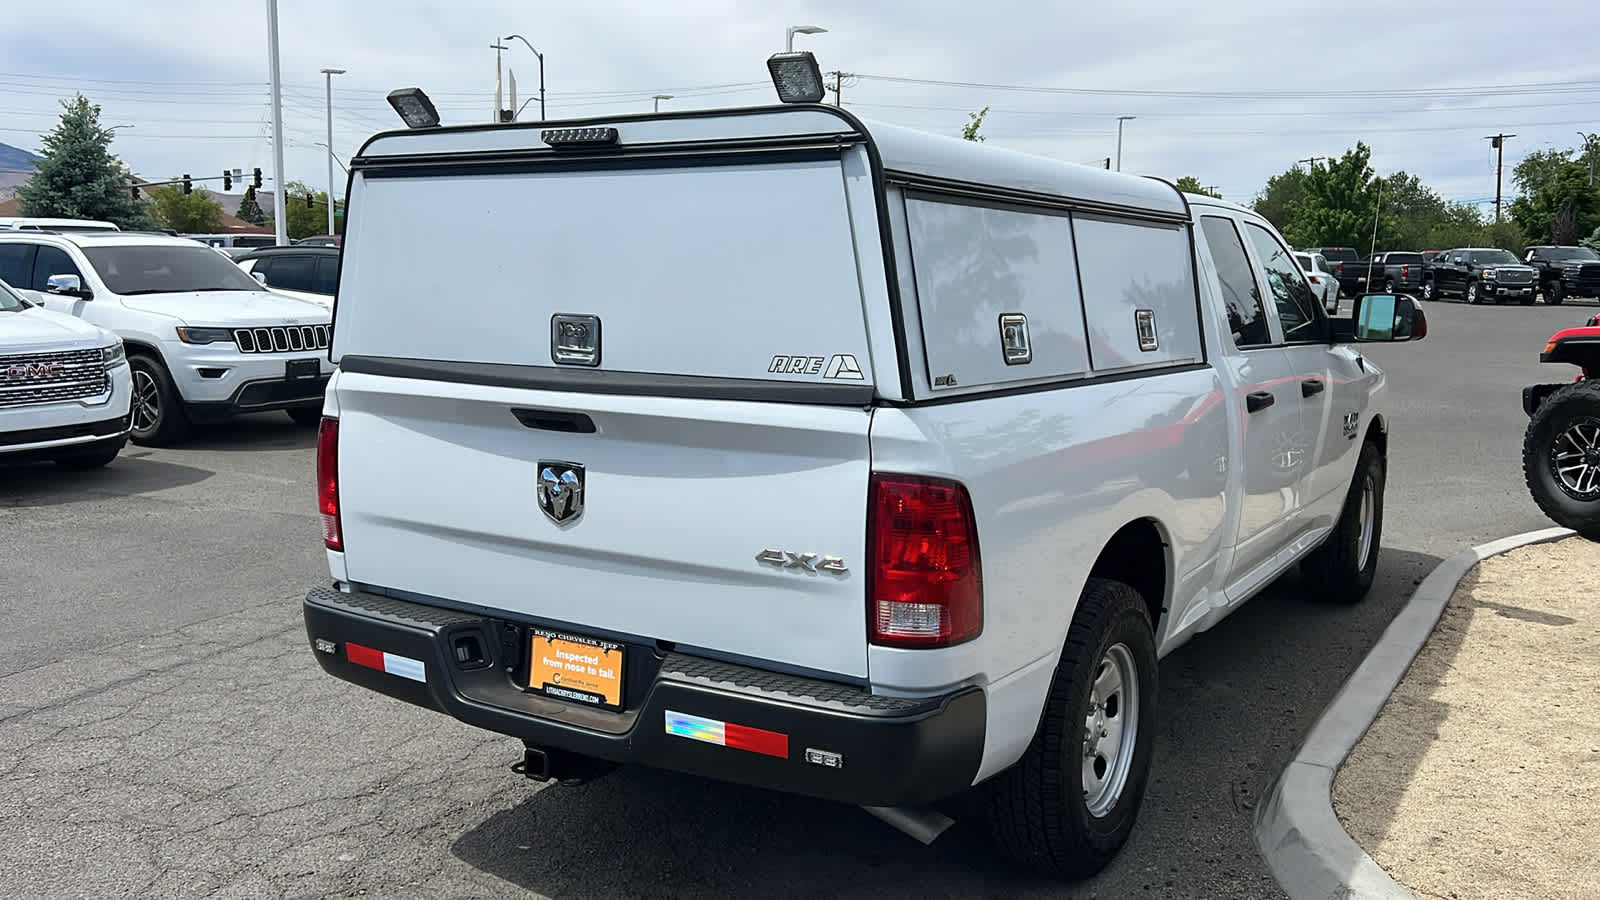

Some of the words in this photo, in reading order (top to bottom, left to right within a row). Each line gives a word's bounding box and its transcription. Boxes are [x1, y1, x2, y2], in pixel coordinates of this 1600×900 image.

[8, 364, 65, 378] GMC
[768, 355, 825, 375] ARE
[558, 633, 598, 647] CHRYSLER
[543, 656, 563, 669] from
[564, 663, 586, 673] nose
[587, 665, 597, 676] to
[556, 649, 599, 666] Inspected
